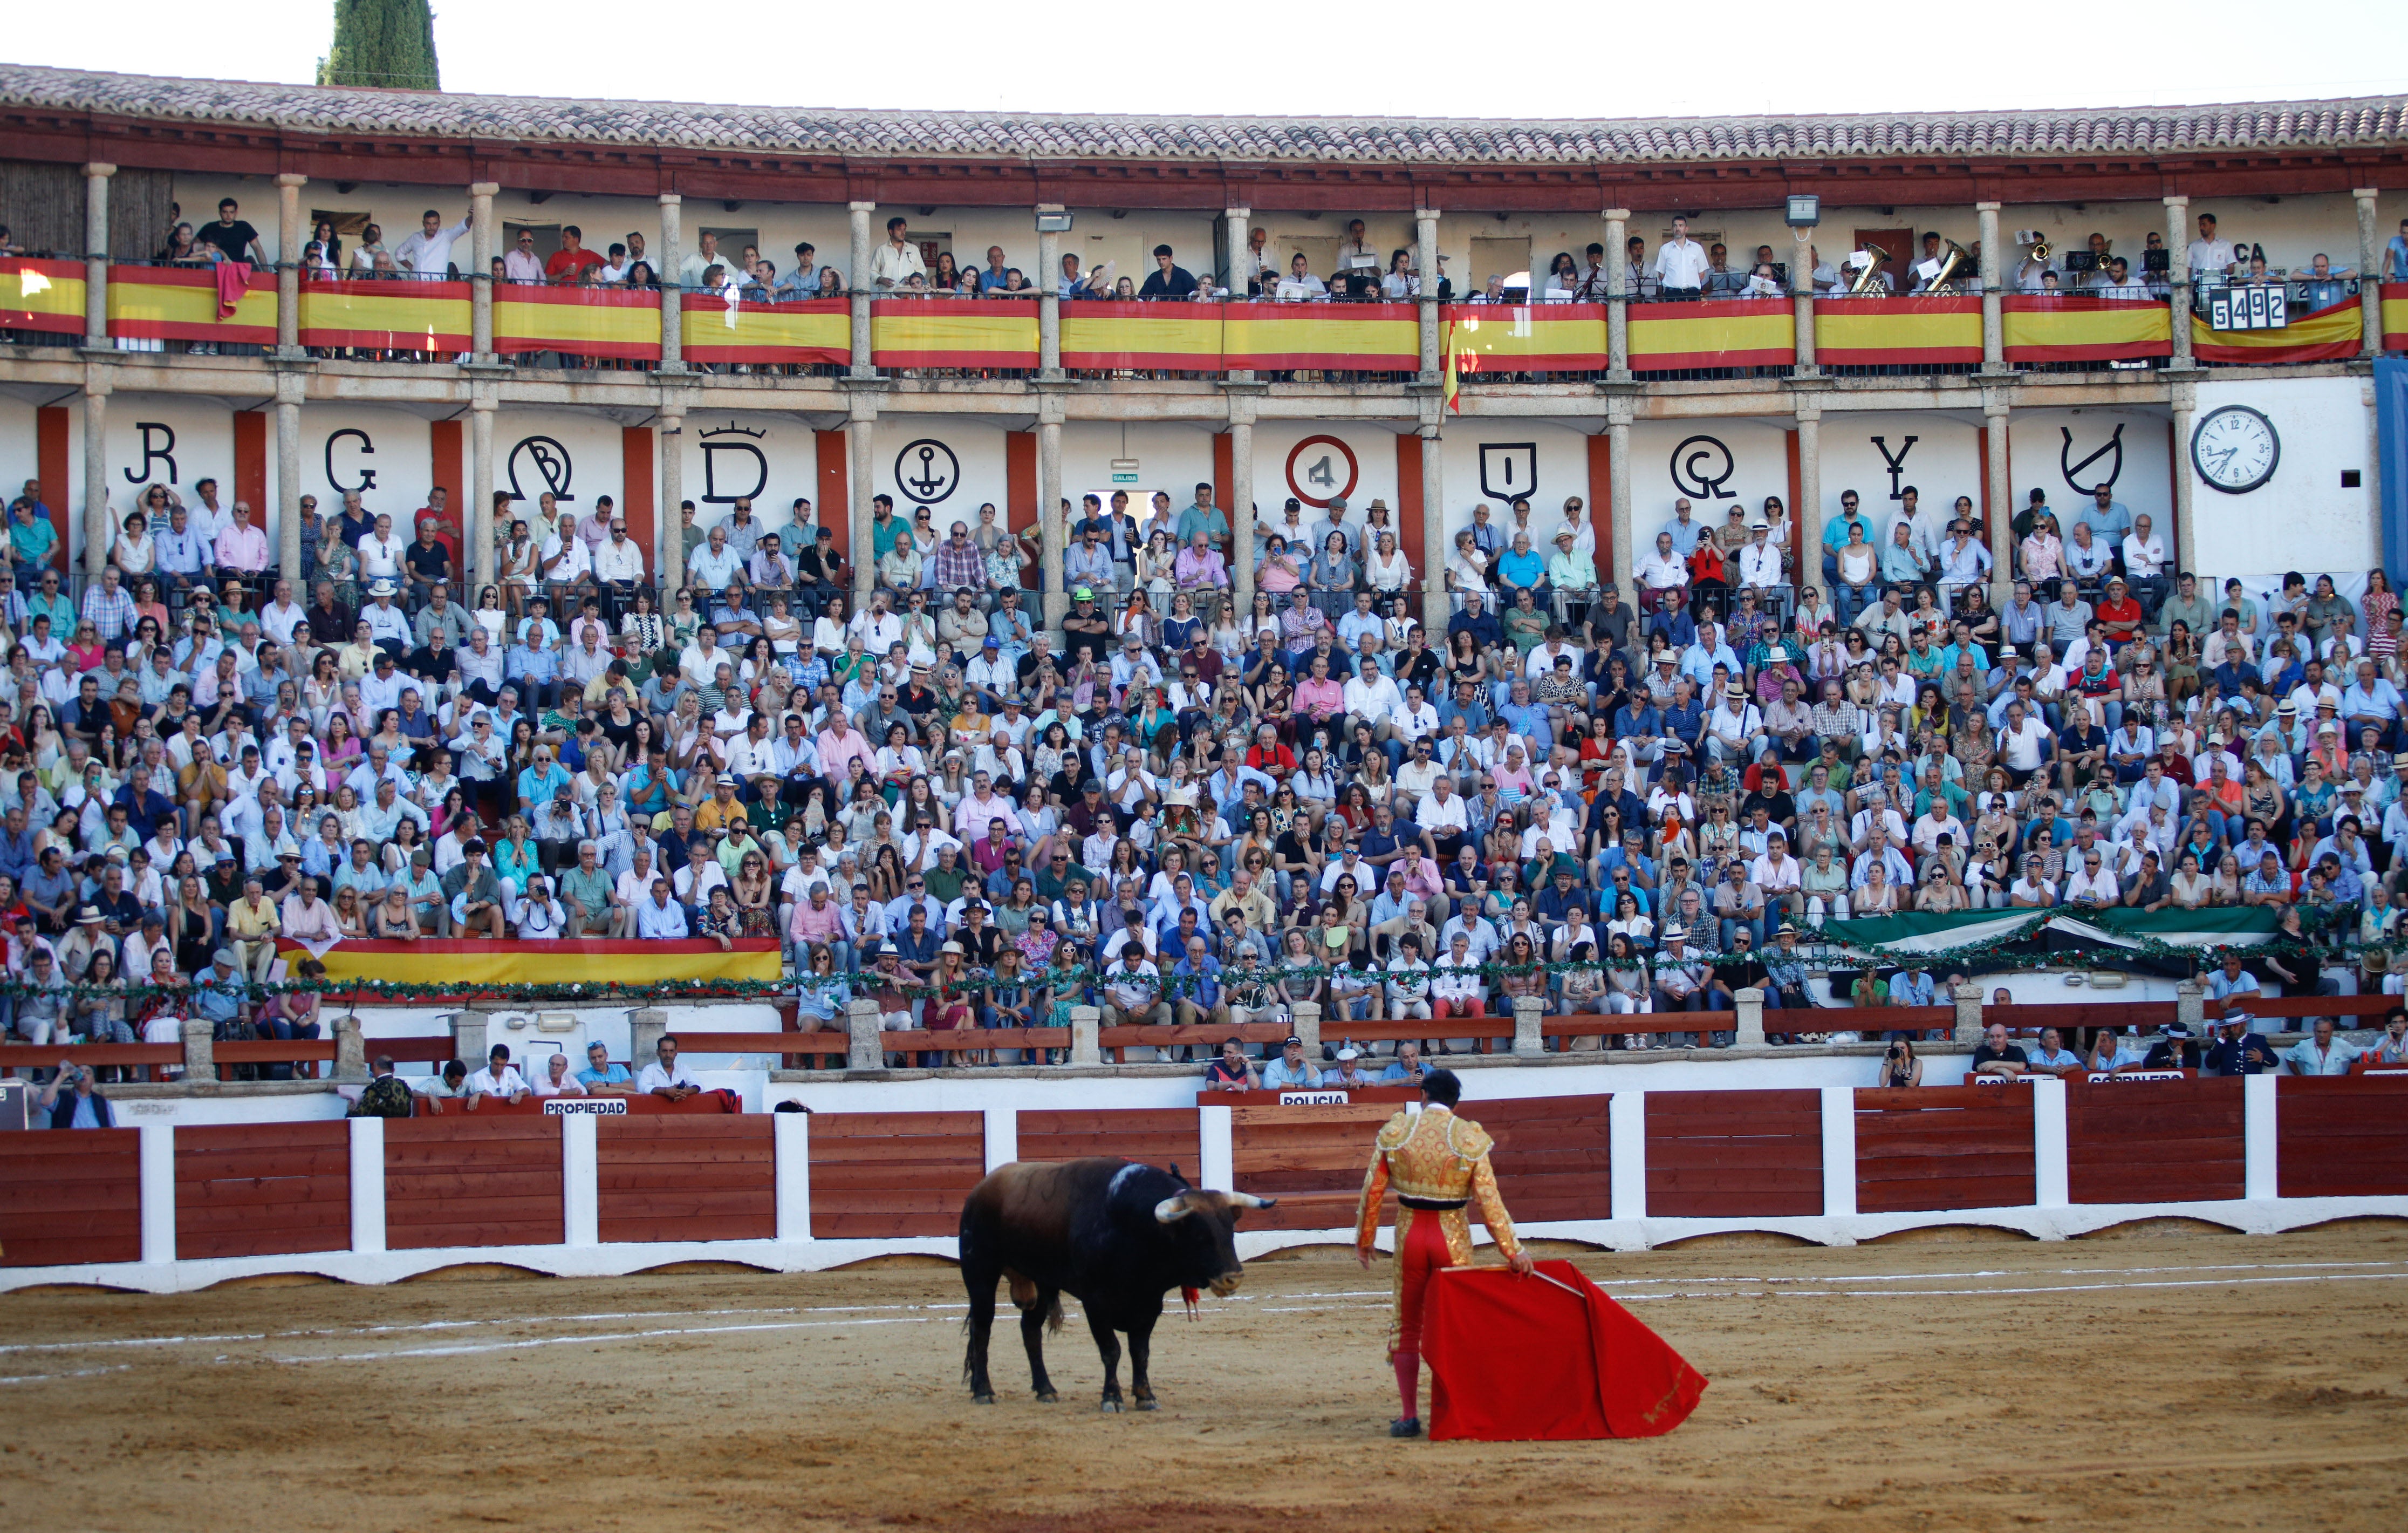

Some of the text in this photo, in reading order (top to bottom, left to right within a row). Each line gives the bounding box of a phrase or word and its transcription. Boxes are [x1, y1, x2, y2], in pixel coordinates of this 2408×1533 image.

[2215, 293, 2283, 325] 5492
[2231, 419, 2239, 430] 12
[2206, 445, 2212, 457] 9
[2259, 444, 2265, 453] 3
[1308, 456, 1337, 488] 4
[2234, 468, 2239, 478] 6
[1284, 1095, 1343, 1105] POLICIA
[545, 1102, 625, 1114] PROPIEDAD
